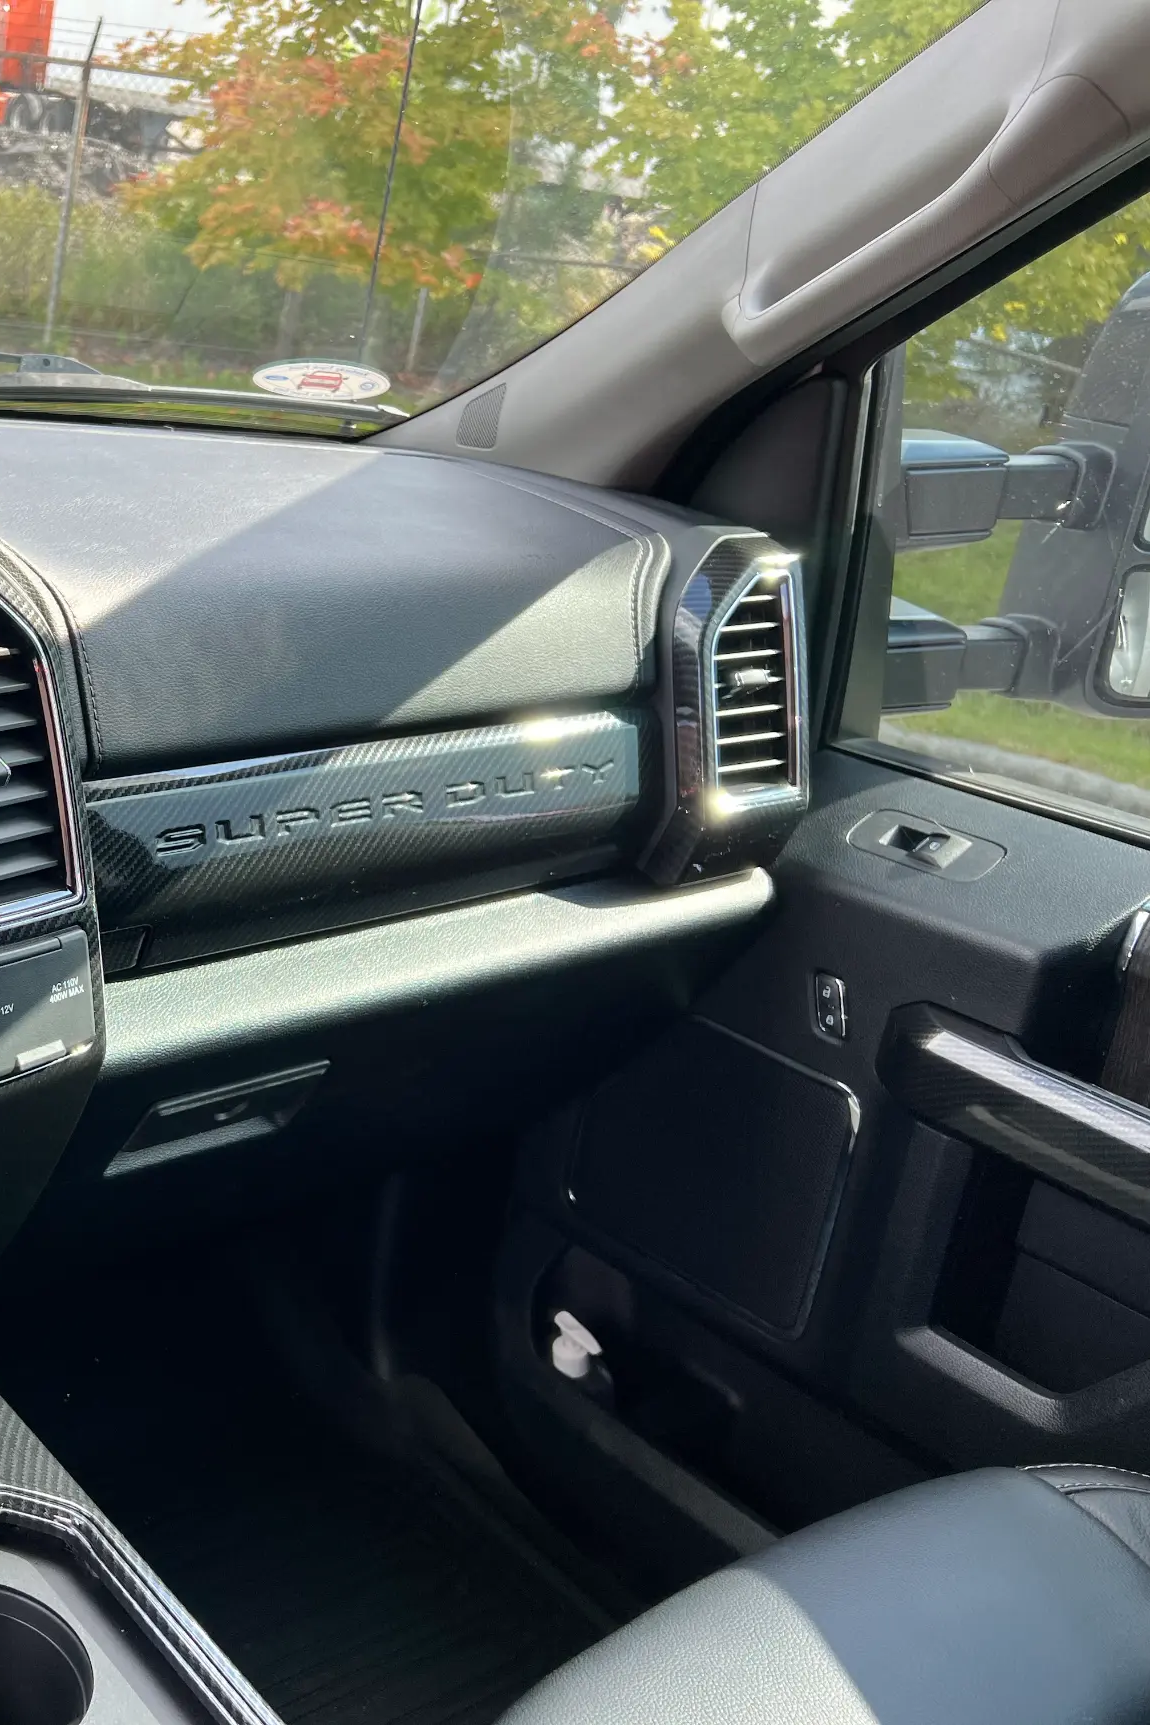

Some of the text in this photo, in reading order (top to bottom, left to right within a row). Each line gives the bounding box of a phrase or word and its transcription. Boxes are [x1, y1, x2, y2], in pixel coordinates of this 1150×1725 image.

[155, 758, 615, 857] SUPER DUTY
[51, 976, 79, 993] AC 110V
[49, 984, 85, 1004] 400W MAX
[0, 1003, 14, 1015] 12V
